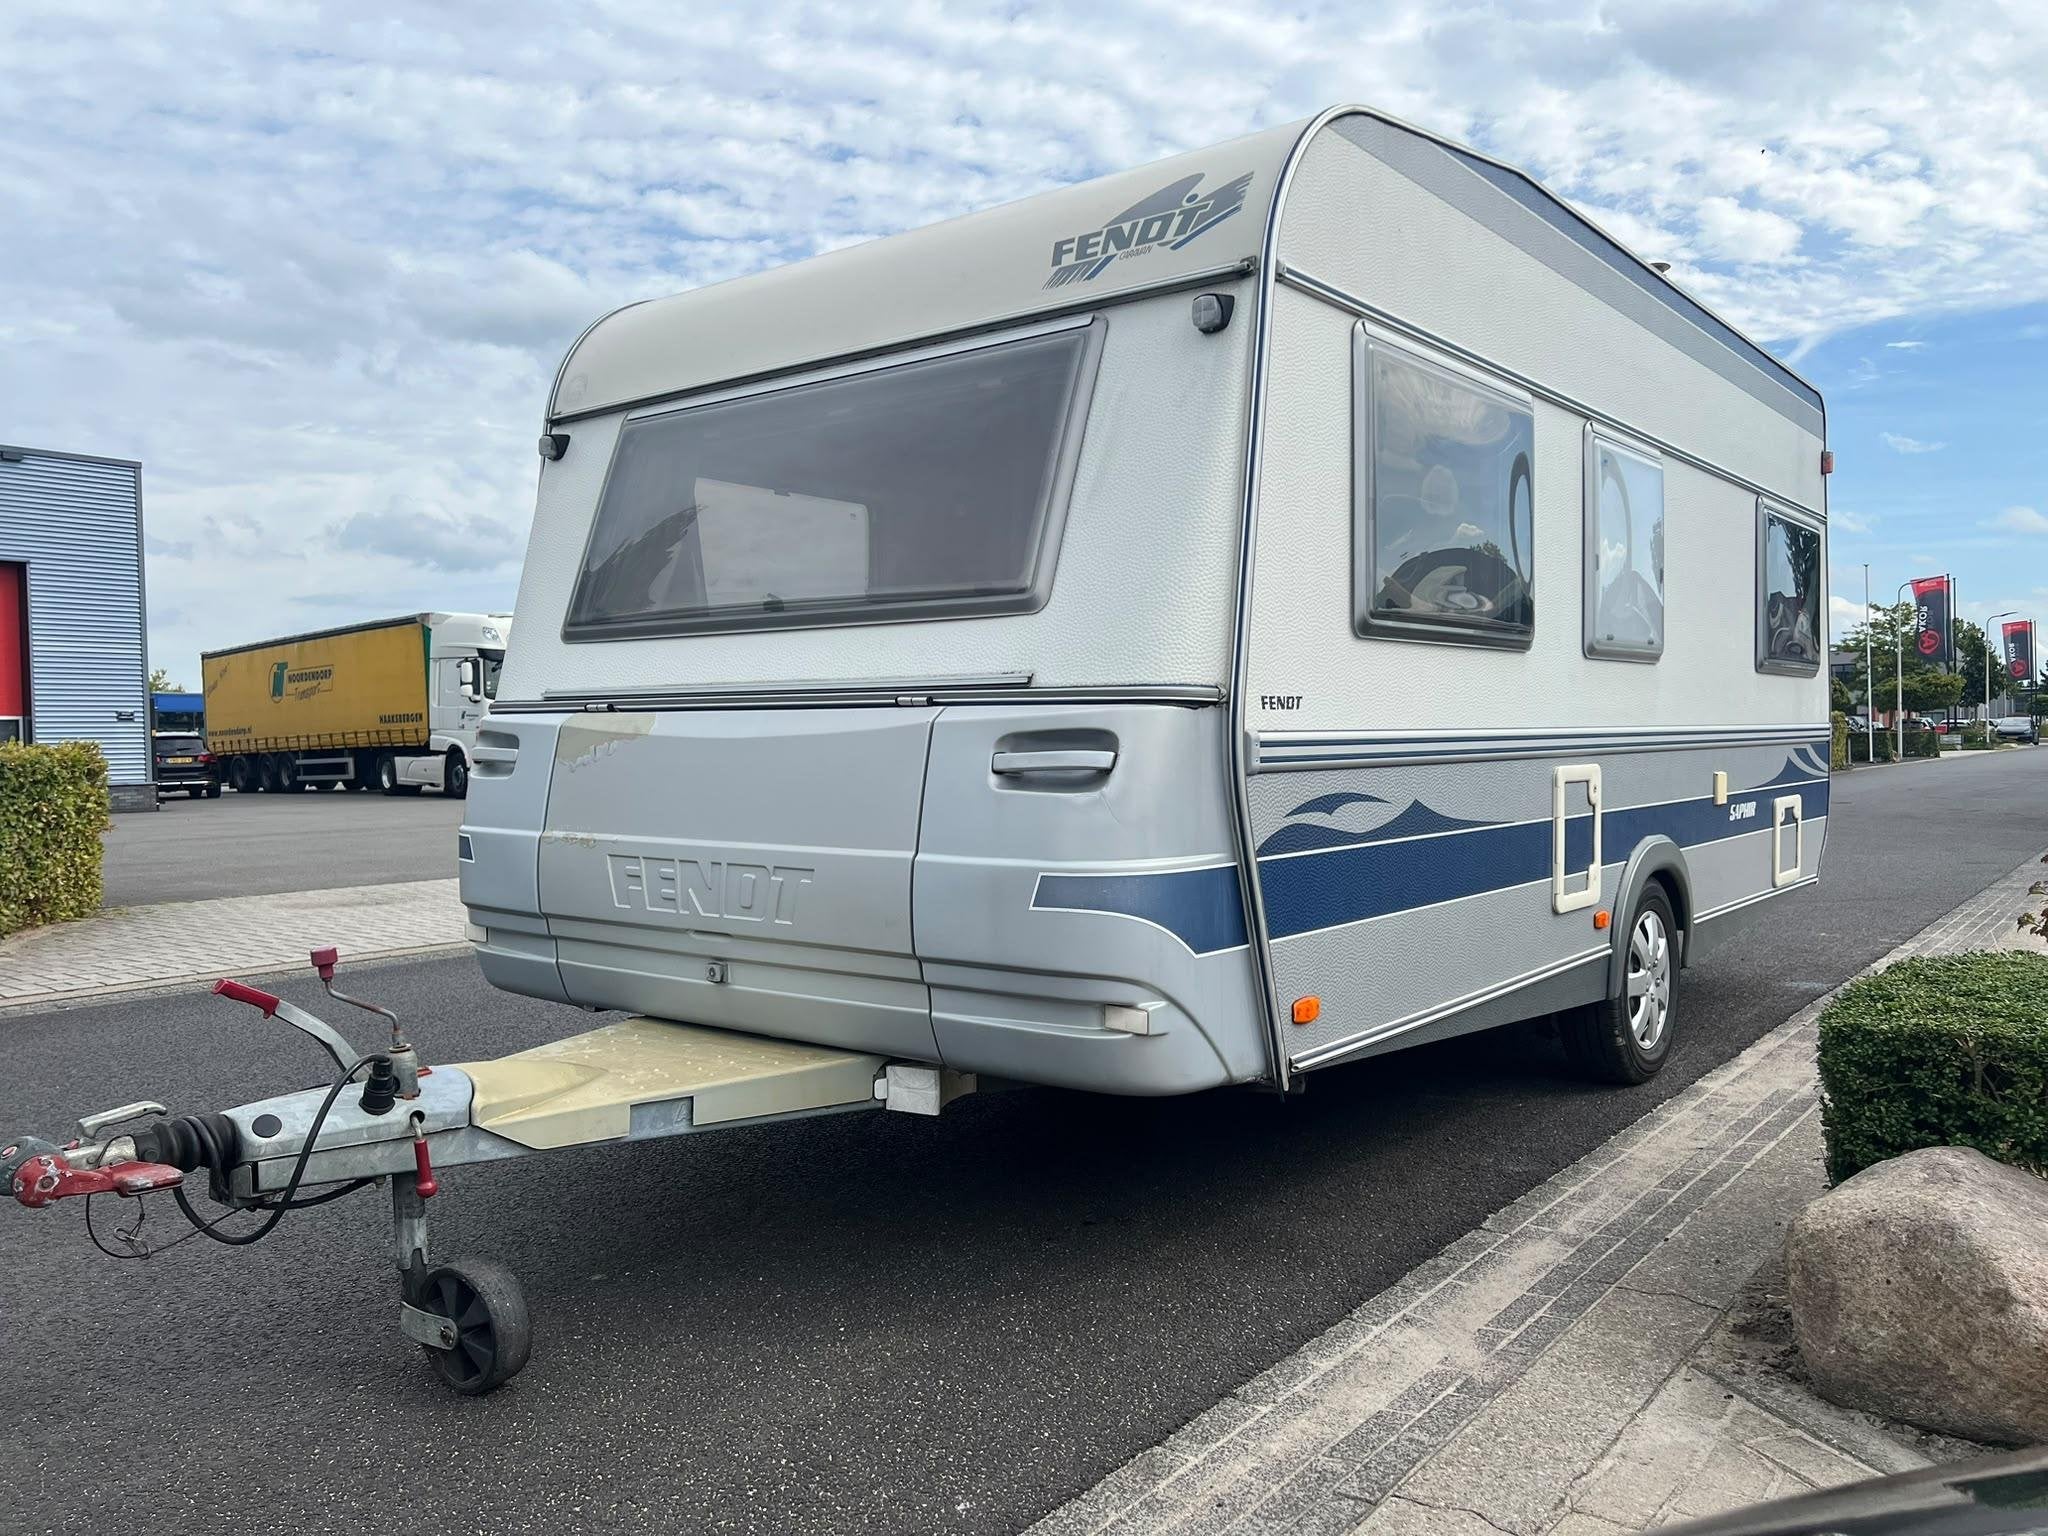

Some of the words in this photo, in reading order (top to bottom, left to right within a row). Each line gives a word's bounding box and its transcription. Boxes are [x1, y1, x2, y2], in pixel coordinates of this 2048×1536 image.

[1051, 202, 1210, 267] FENDT
[288, 668, 332, 684] NOORDENDORP
[1261, 695, 1303, 710] FENDT
[378, 711, 423, 724] HAAKSBERGEN
[1729, 801, 1757, 821] SAPHIR
[607, 854, 815, 925] FENDT
